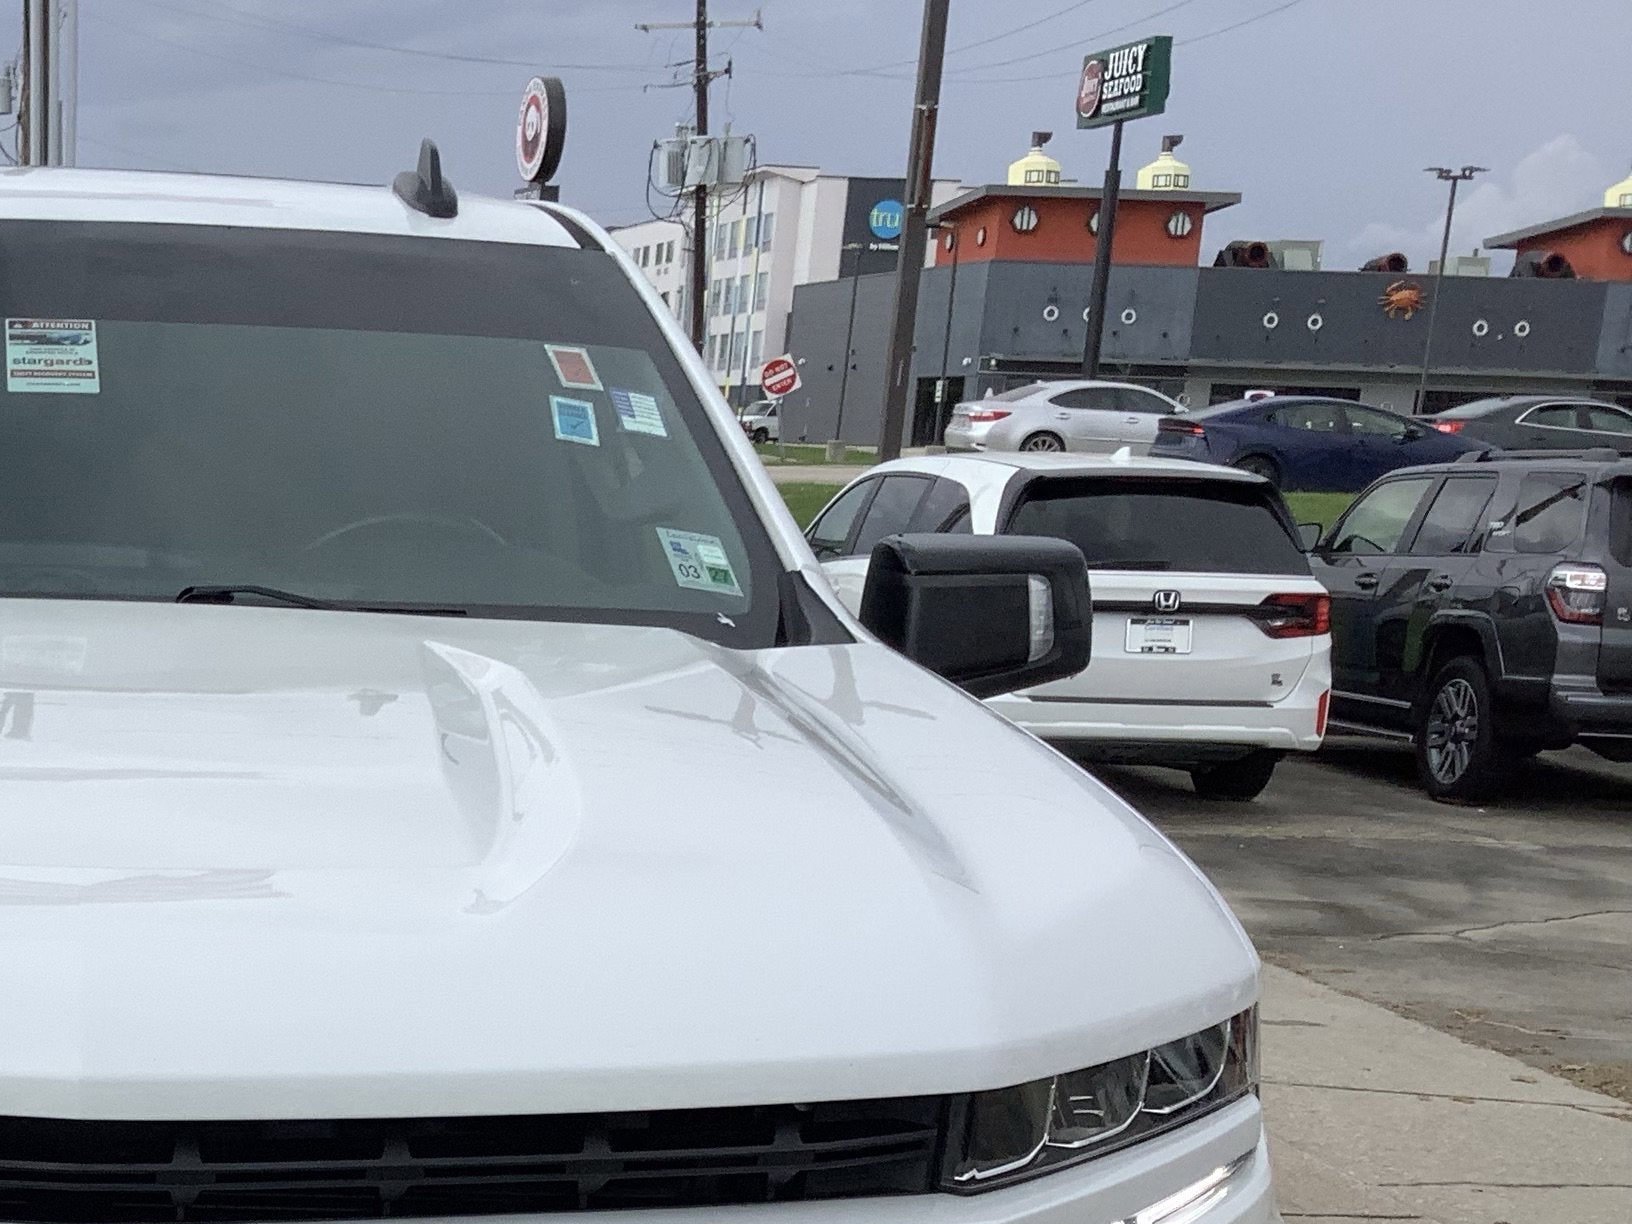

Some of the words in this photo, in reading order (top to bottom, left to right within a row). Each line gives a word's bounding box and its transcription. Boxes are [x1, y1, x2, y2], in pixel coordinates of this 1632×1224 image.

[1104, 43, 1147, 80] JUICY
[1102, 73, 1142, 100] SEAFOOD
[871, 208, 900, 228] tru
[31, 321, 90, 329] ATTENTION
[678, 563, 701, 579] 03
